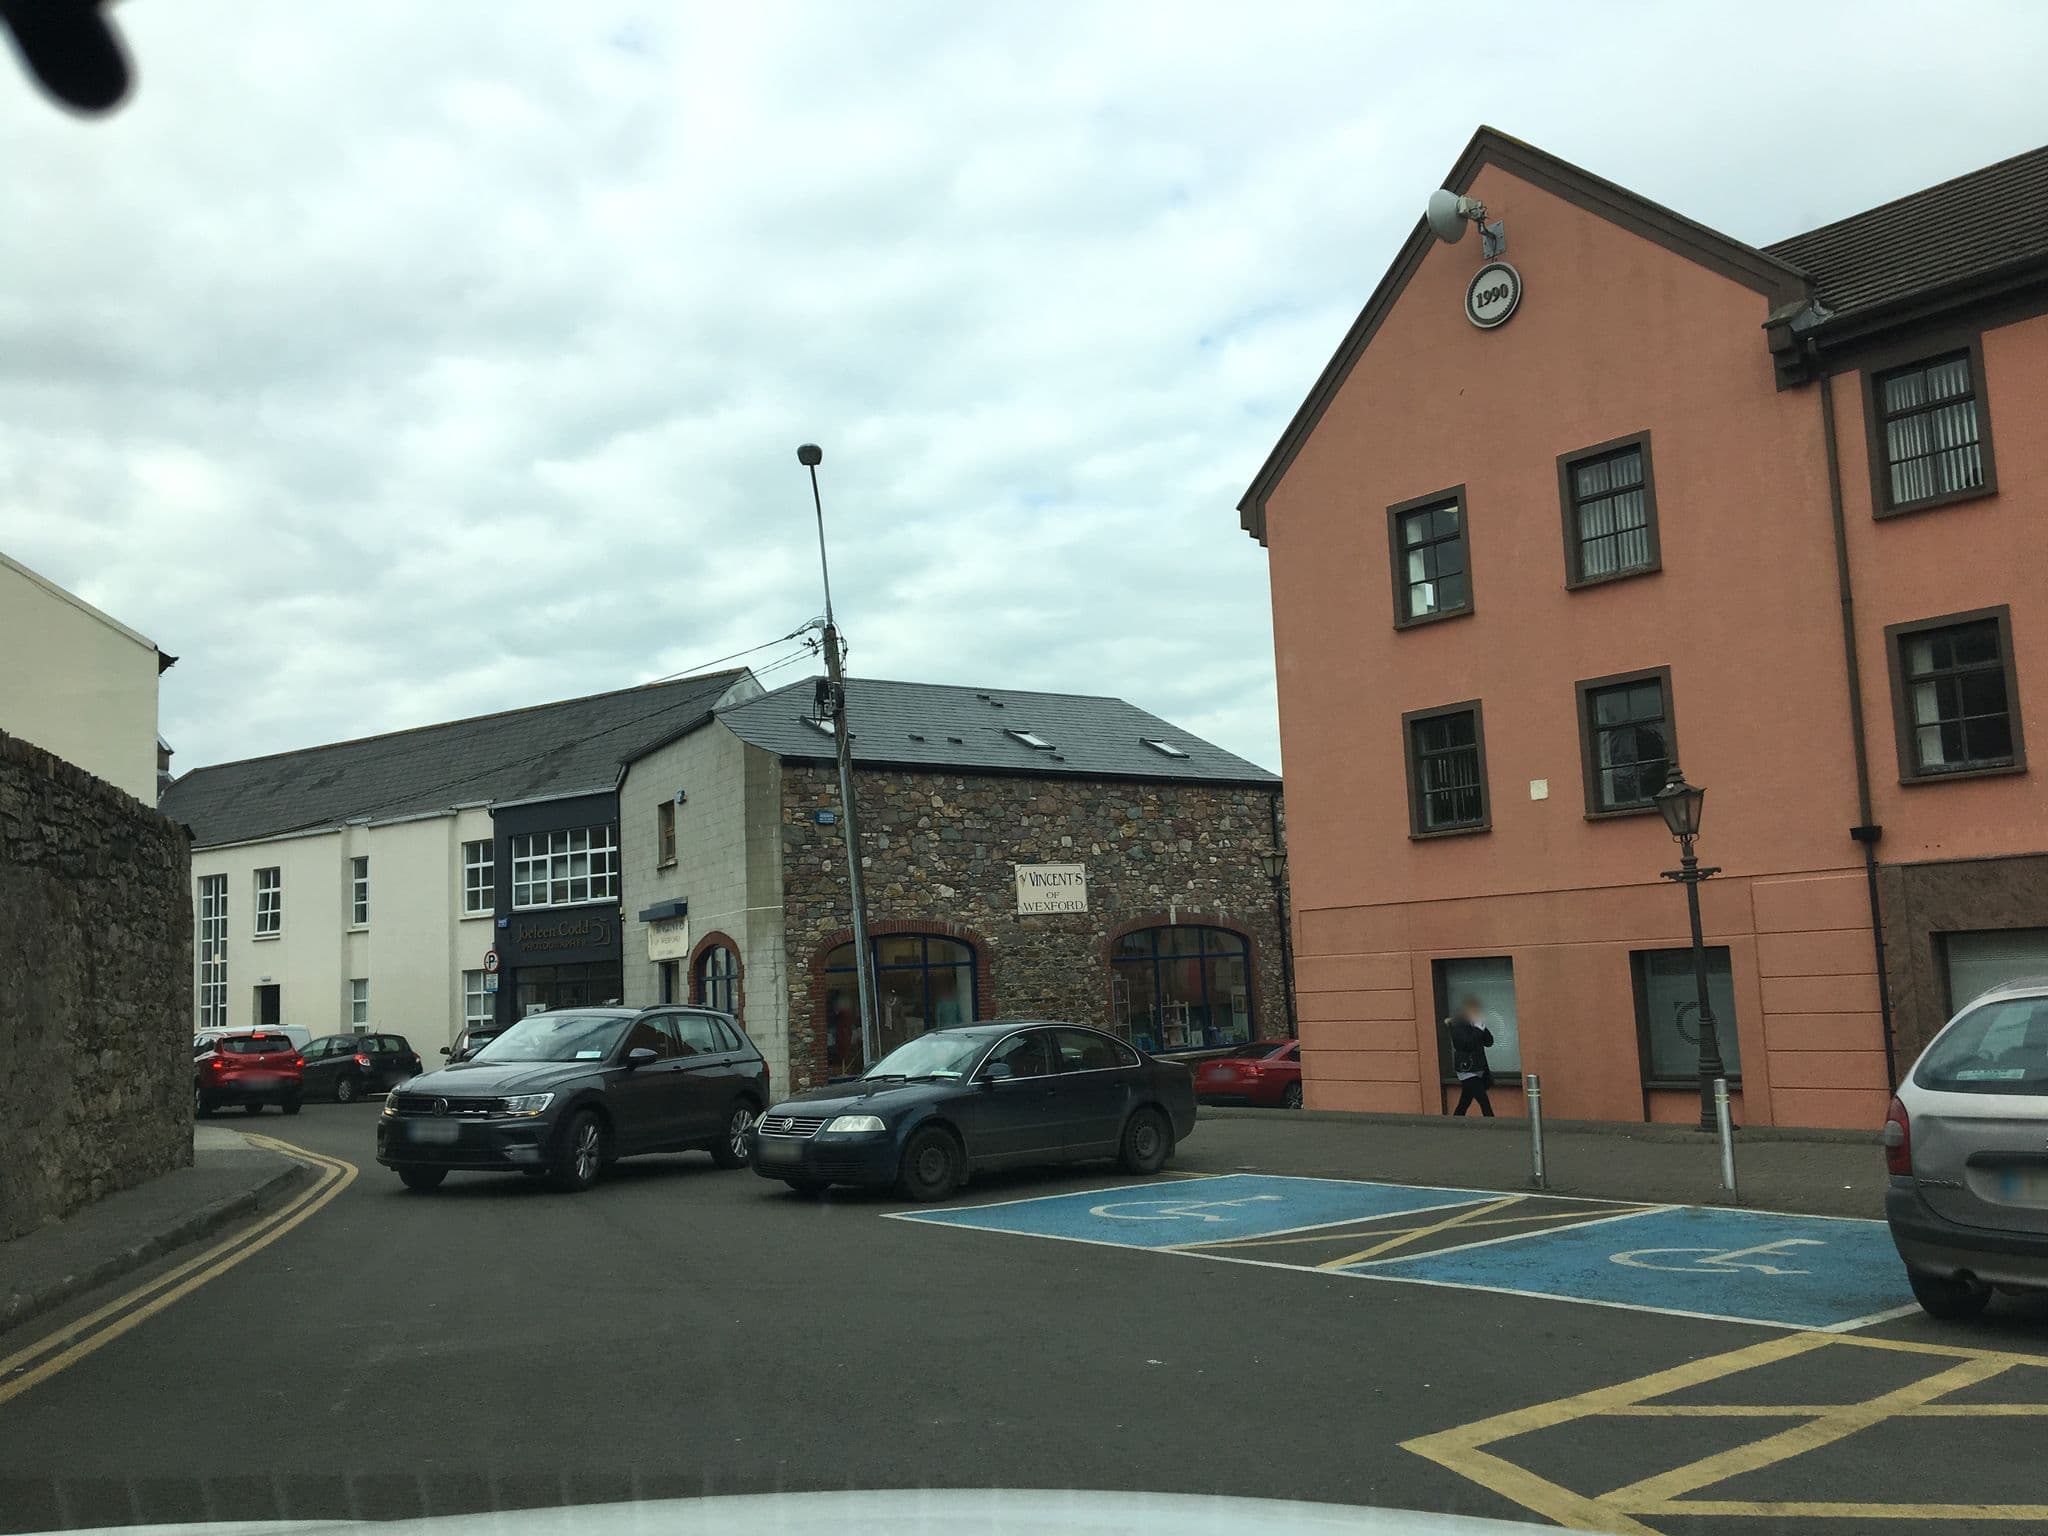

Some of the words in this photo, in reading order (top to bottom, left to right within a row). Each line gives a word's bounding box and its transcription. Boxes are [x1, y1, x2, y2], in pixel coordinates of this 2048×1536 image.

[1476, 284, 1509, 309] 1990
[1046, 891, 1060, 899] OF
[1023, 900, 1084, 912] WEXFORD
[488, 954, 496, 969] P
